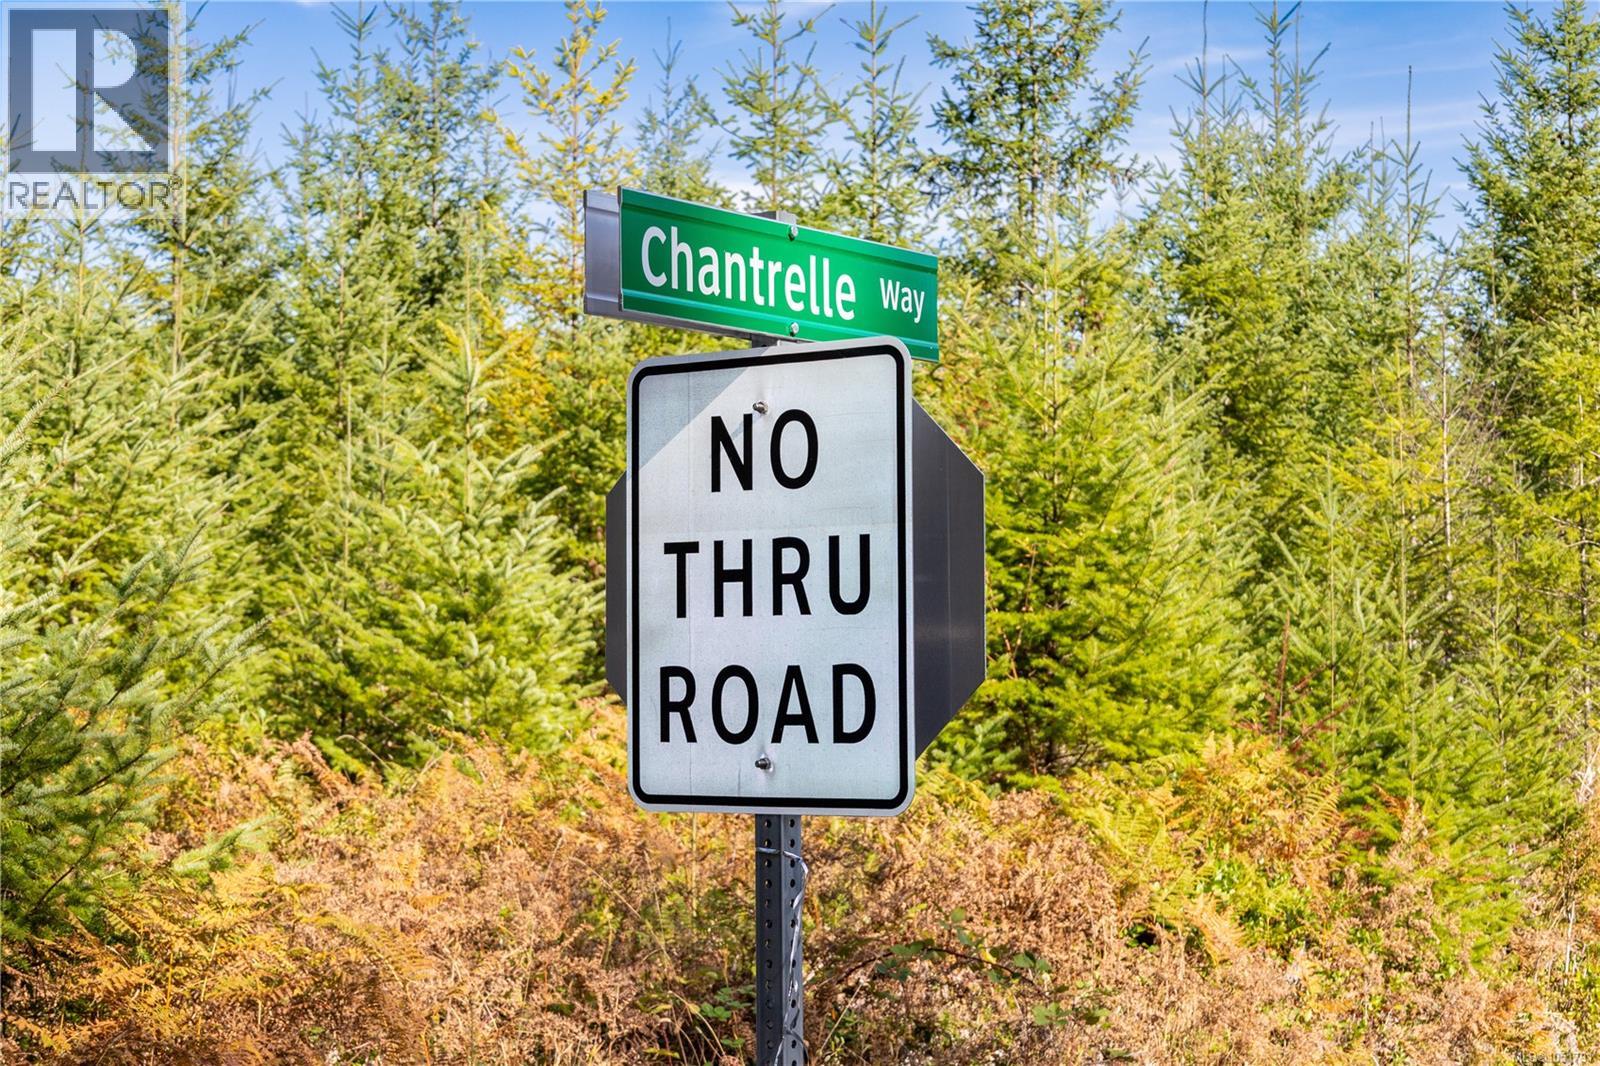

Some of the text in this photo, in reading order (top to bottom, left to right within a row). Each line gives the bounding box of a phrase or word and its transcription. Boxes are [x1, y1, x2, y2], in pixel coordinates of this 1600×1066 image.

[641, 226, 926, 323] Chantrelle Way
[711, 409, 819, 492] NO
[663, 533, 871, 619] THRU
[659, 663, 877, 744] ROAD
